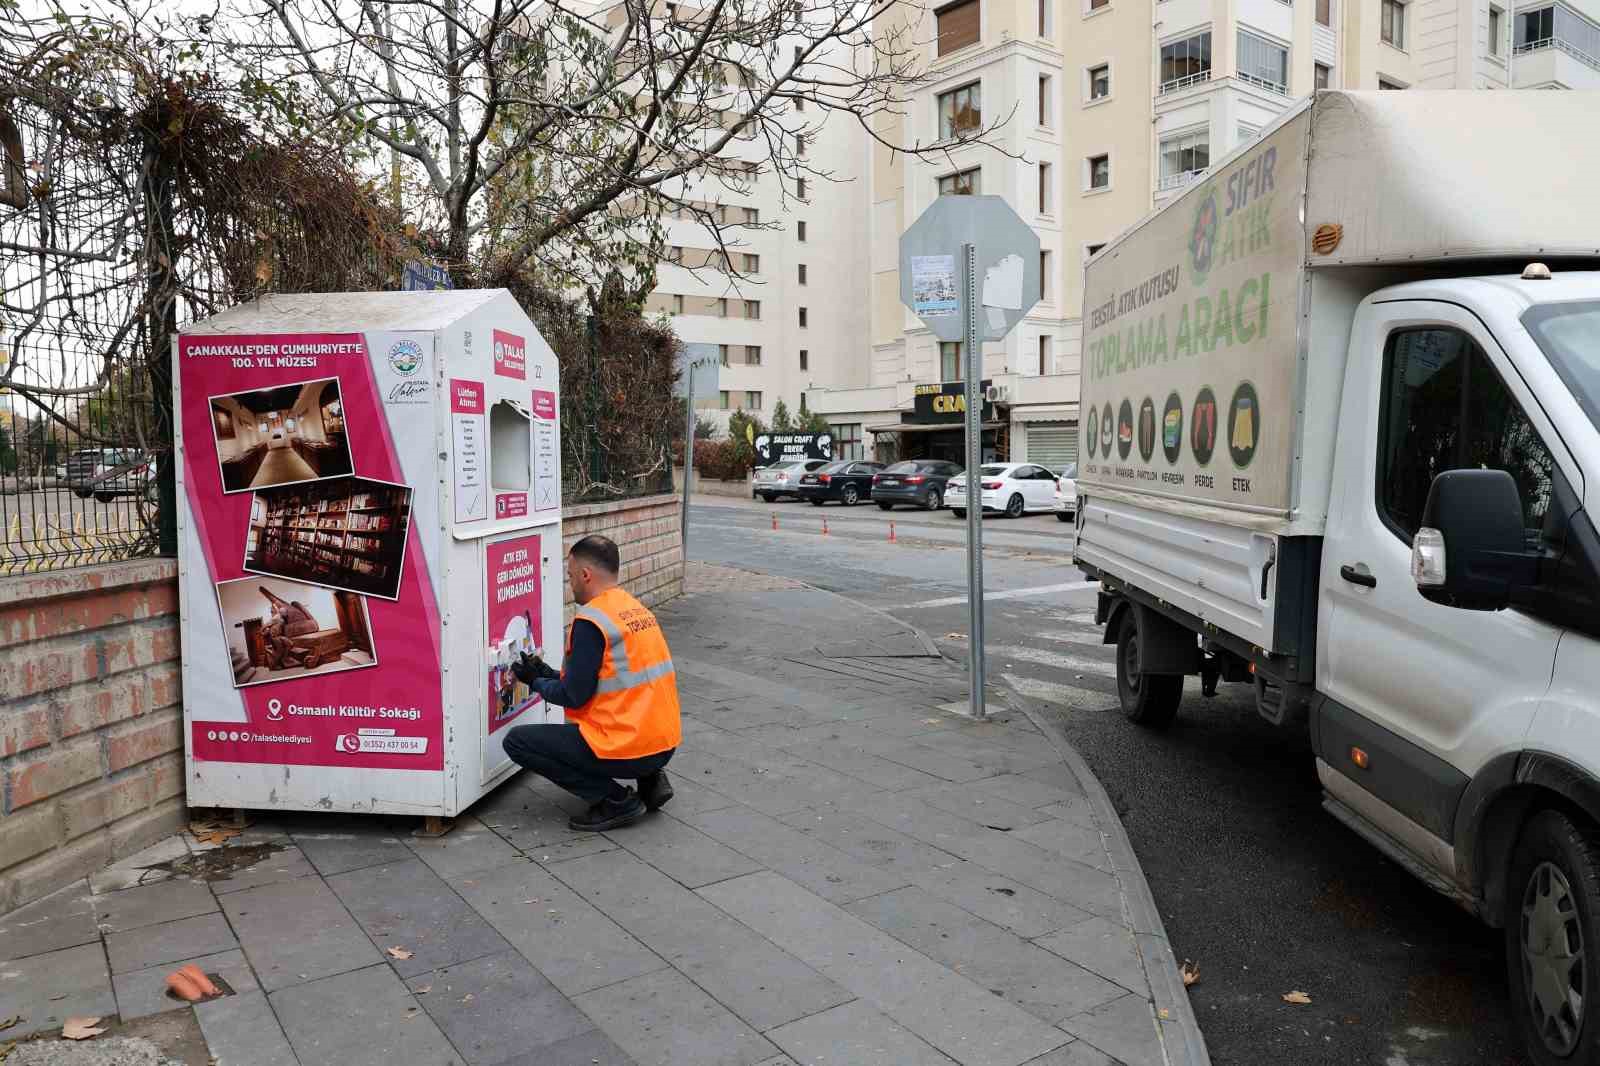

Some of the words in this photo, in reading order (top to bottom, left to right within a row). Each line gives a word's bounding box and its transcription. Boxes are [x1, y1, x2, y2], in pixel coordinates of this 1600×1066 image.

[1225, 146, 1277, 216] SIFIR
[1221, 199, 1272, 267] ATIK
[1090, 293, 1117, 330] TEKSTİL
[1117, 284, 1138, 317] ATIK
[1139, 264, 1180, 308] KUTUSU
[1089, 313, 1169, 380] TOPLAMA
[1174, 272, 1272, 360] ARACI
[187, 345, 280, 358] ÇANAKKALE'DEN
[281, 343, 363, 355] CUMHURİYET'E
[503, 344, 525, 360] TALAS
[232, 357, 255, 369] 100.
[257, 357, 275, 368] YIL
[276, 355, 317, 368] MÜZESİ
[457, 387, 477, 398] Lütfen
[933, 394, 967, 413] CRA
[773, 435, 793, 443] SALON
[794, 435, 814, 443] CRAFT
[1194, 474, 1214, 489] PERDE
[1232, 478, 1251, 493] ETEK
[502, 552, 515, 566] ATIK
[497, 579, 534, 605] KUMBARASI
[288, 704, 336, 717] Osmanlı
[339, 704, 376, 718] Kültür
[379, 706, 421, 720] Sokağı
[250, 734, 312, 745] /talasbelediyesi
[363, 740, 386, 749] 0(352)
[387, 741, 399, 749] 437
[400, 741, 409, 749] 00
[410, 741, 418, 749] 54
